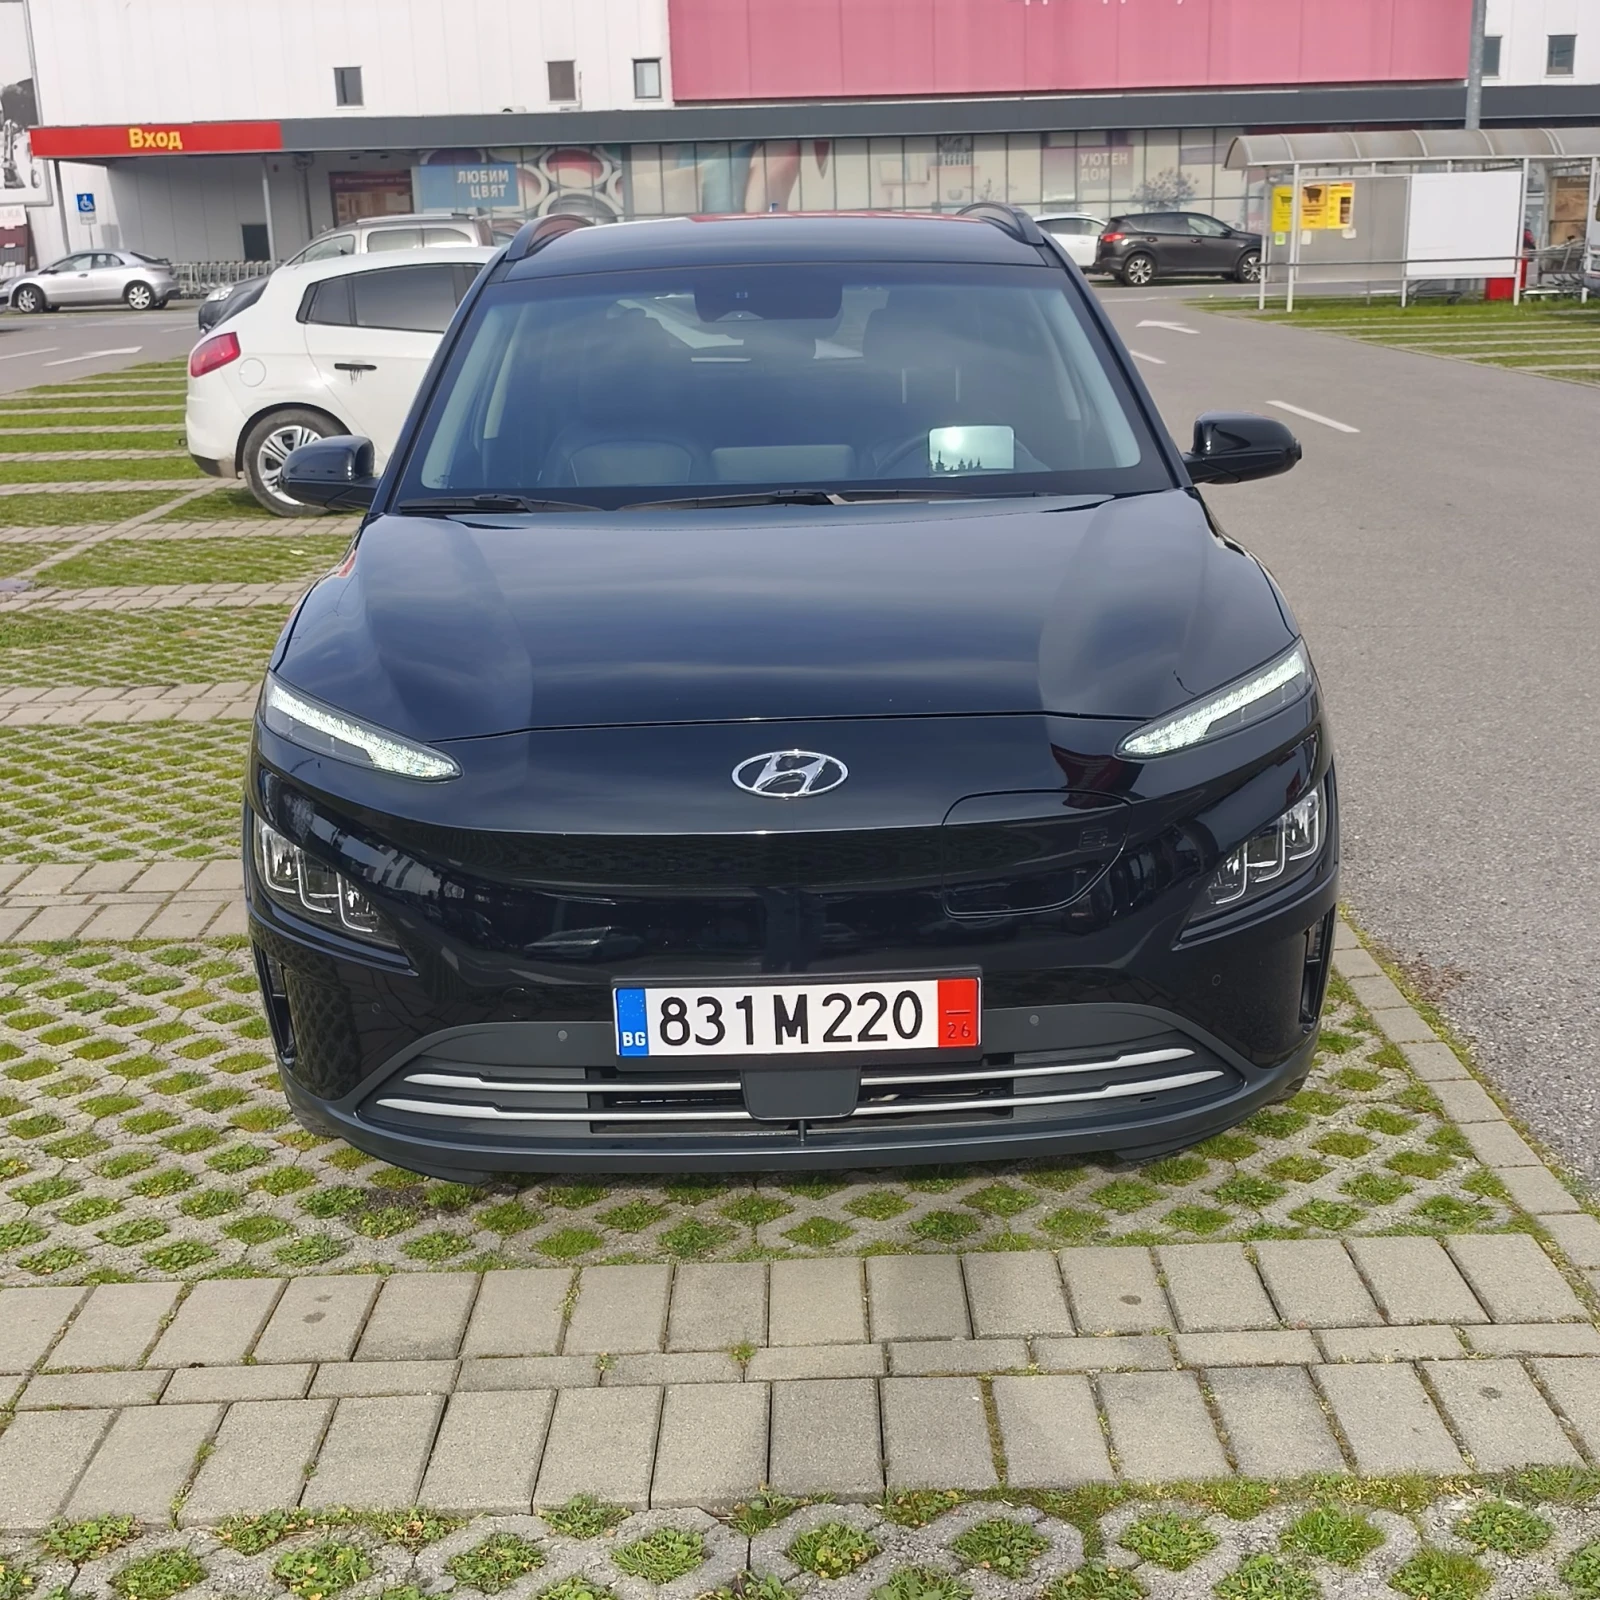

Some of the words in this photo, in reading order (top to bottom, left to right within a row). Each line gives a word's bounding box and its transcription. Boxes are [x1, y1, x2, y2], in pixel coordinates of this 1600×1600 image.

[128, 127, 184, 151] Вход
[1080, 152, 1129, 167] УЮТЕН
[457, 169, 509, 184] ЛЮБИМ
[1080, 167, 1110, 183] ДОМ
[470, 184, 507, 200] ЦВЯТ
[947, 1021, 971, 1040] 26
[622, 1031, 646, 1047] BG
